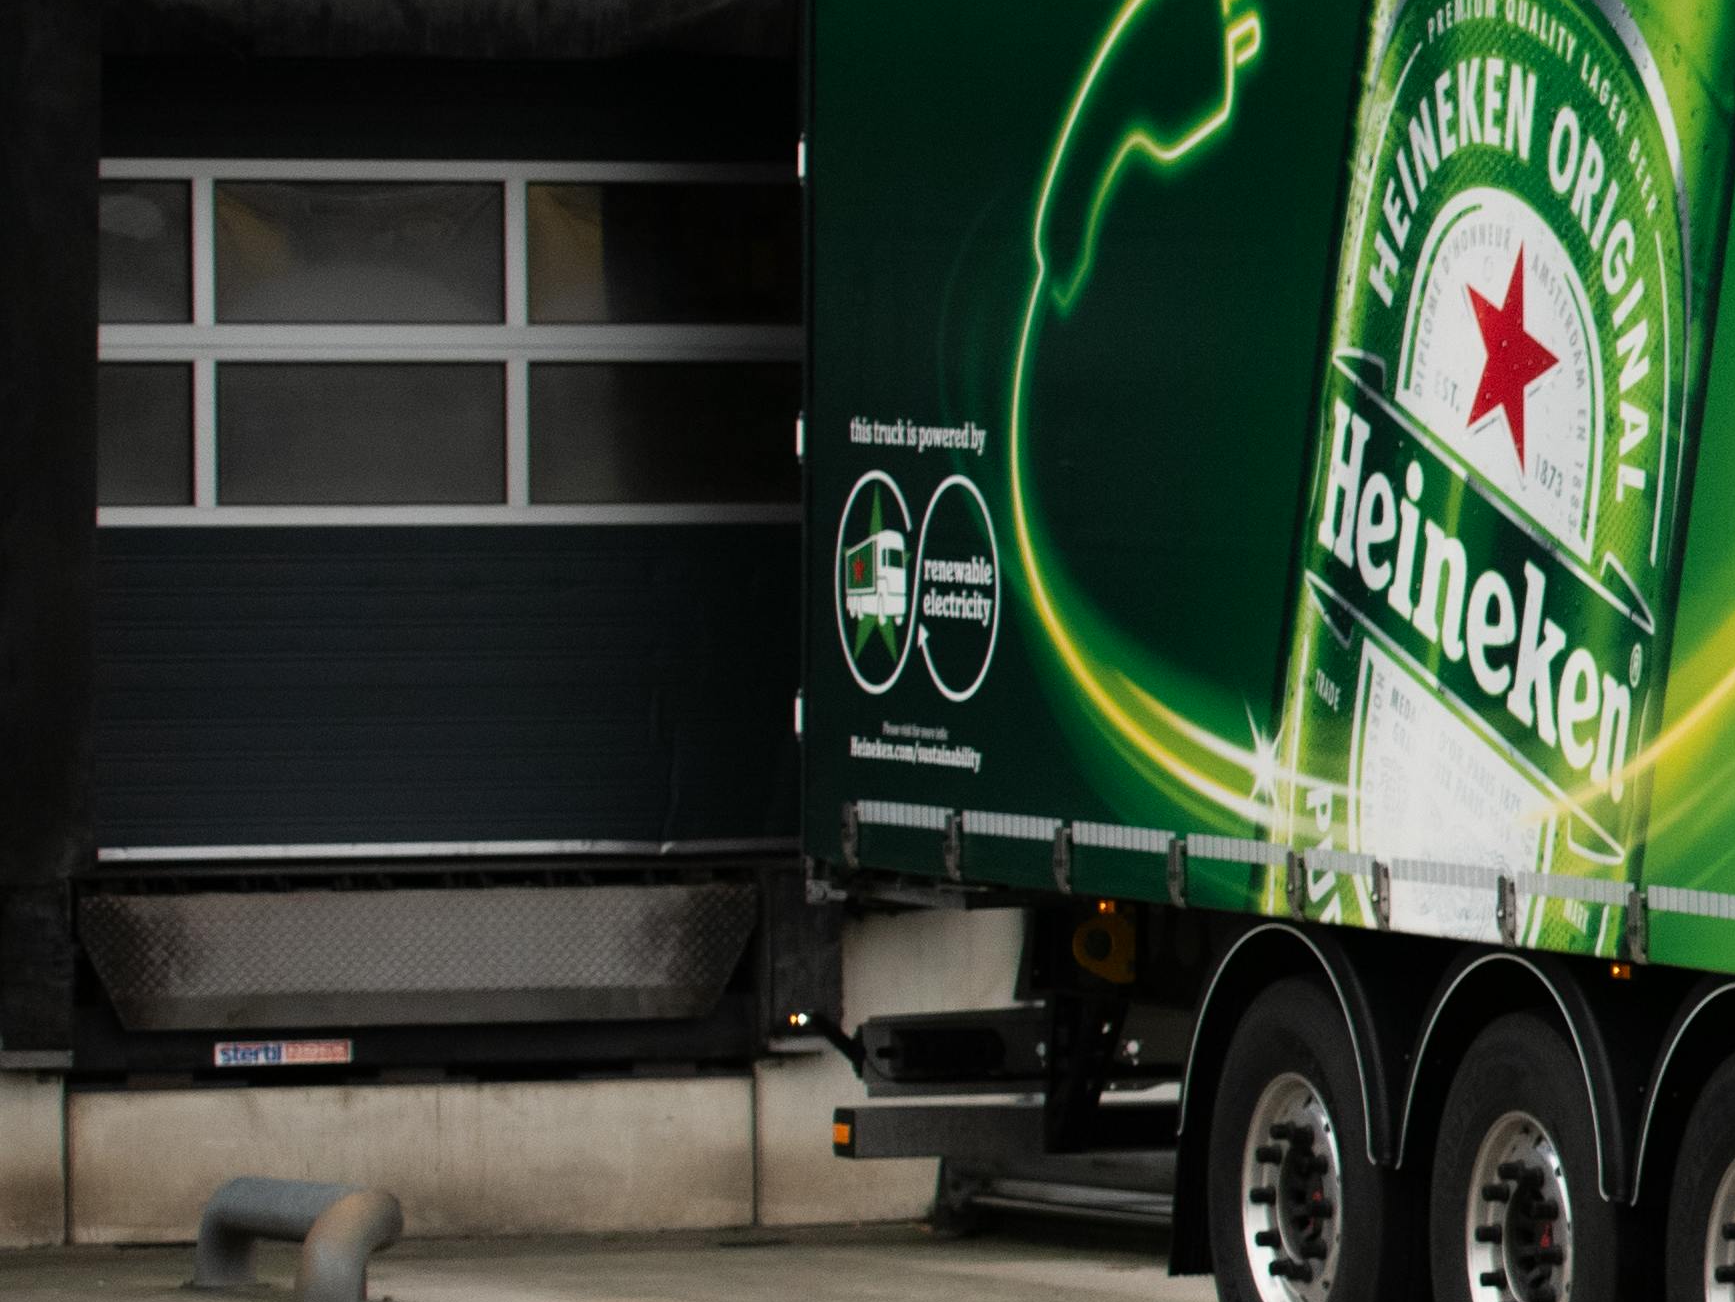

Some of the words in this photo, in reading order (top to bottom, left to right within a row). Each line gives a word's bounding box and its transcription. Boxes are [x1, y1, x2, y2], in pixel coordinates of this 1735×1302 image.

[1580, 53, 1627, 137] LAGER
[1628, 139, 1658, 219] BEER
[1368, 55, 1538, 308] HEINEKEN
[1548, 105, 1650, 502] ORIGINAL
[850, 416, 872, 444] this
[873, 418, 905, 445] truck
[906, 419, 917, 447] is
[918, 421, 969, 453] powered
[970, 421, 986, 456] by
[923, 555, 994, 585] renewable
[923, 588, 993, 627] electricity
[1315, 667, 1341, 713] TRADE
